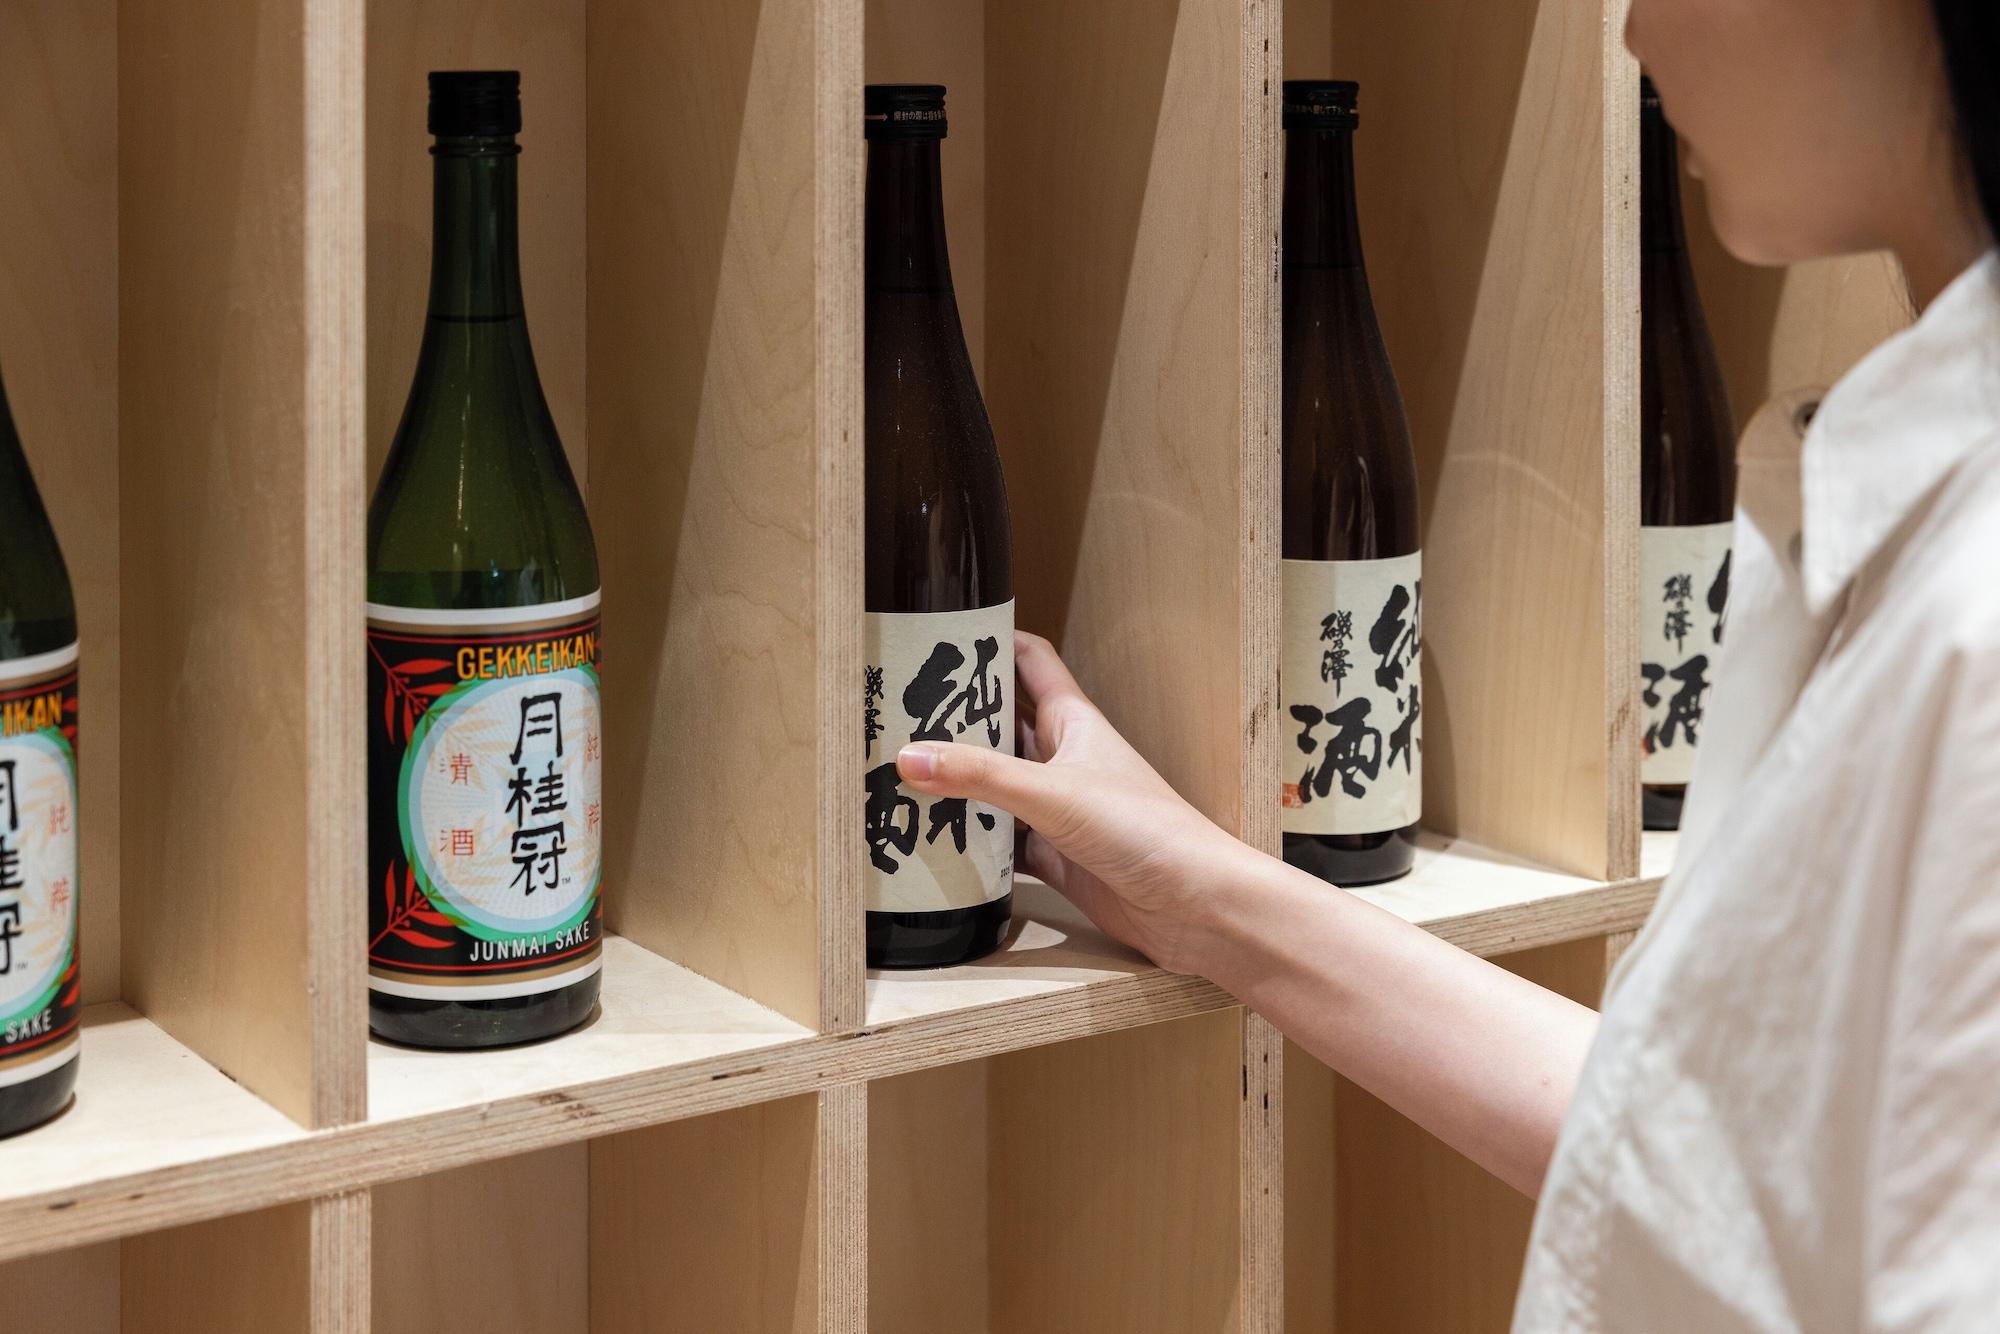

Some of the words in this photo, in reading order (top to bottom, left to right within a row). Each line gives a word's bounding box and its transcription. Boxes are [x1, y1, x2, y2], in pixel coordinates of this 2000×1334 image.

[456, 632, 595, 681] GEKKEIKAN
[1289, 697, 1382, 804] 酒
[505, 692, 568, 896] 月桂冠
[469, 936, 548, 962] JUNMAI
[555, 920, 590, 950] SAKE
[5, 1009, 52, 1043] SAKE
